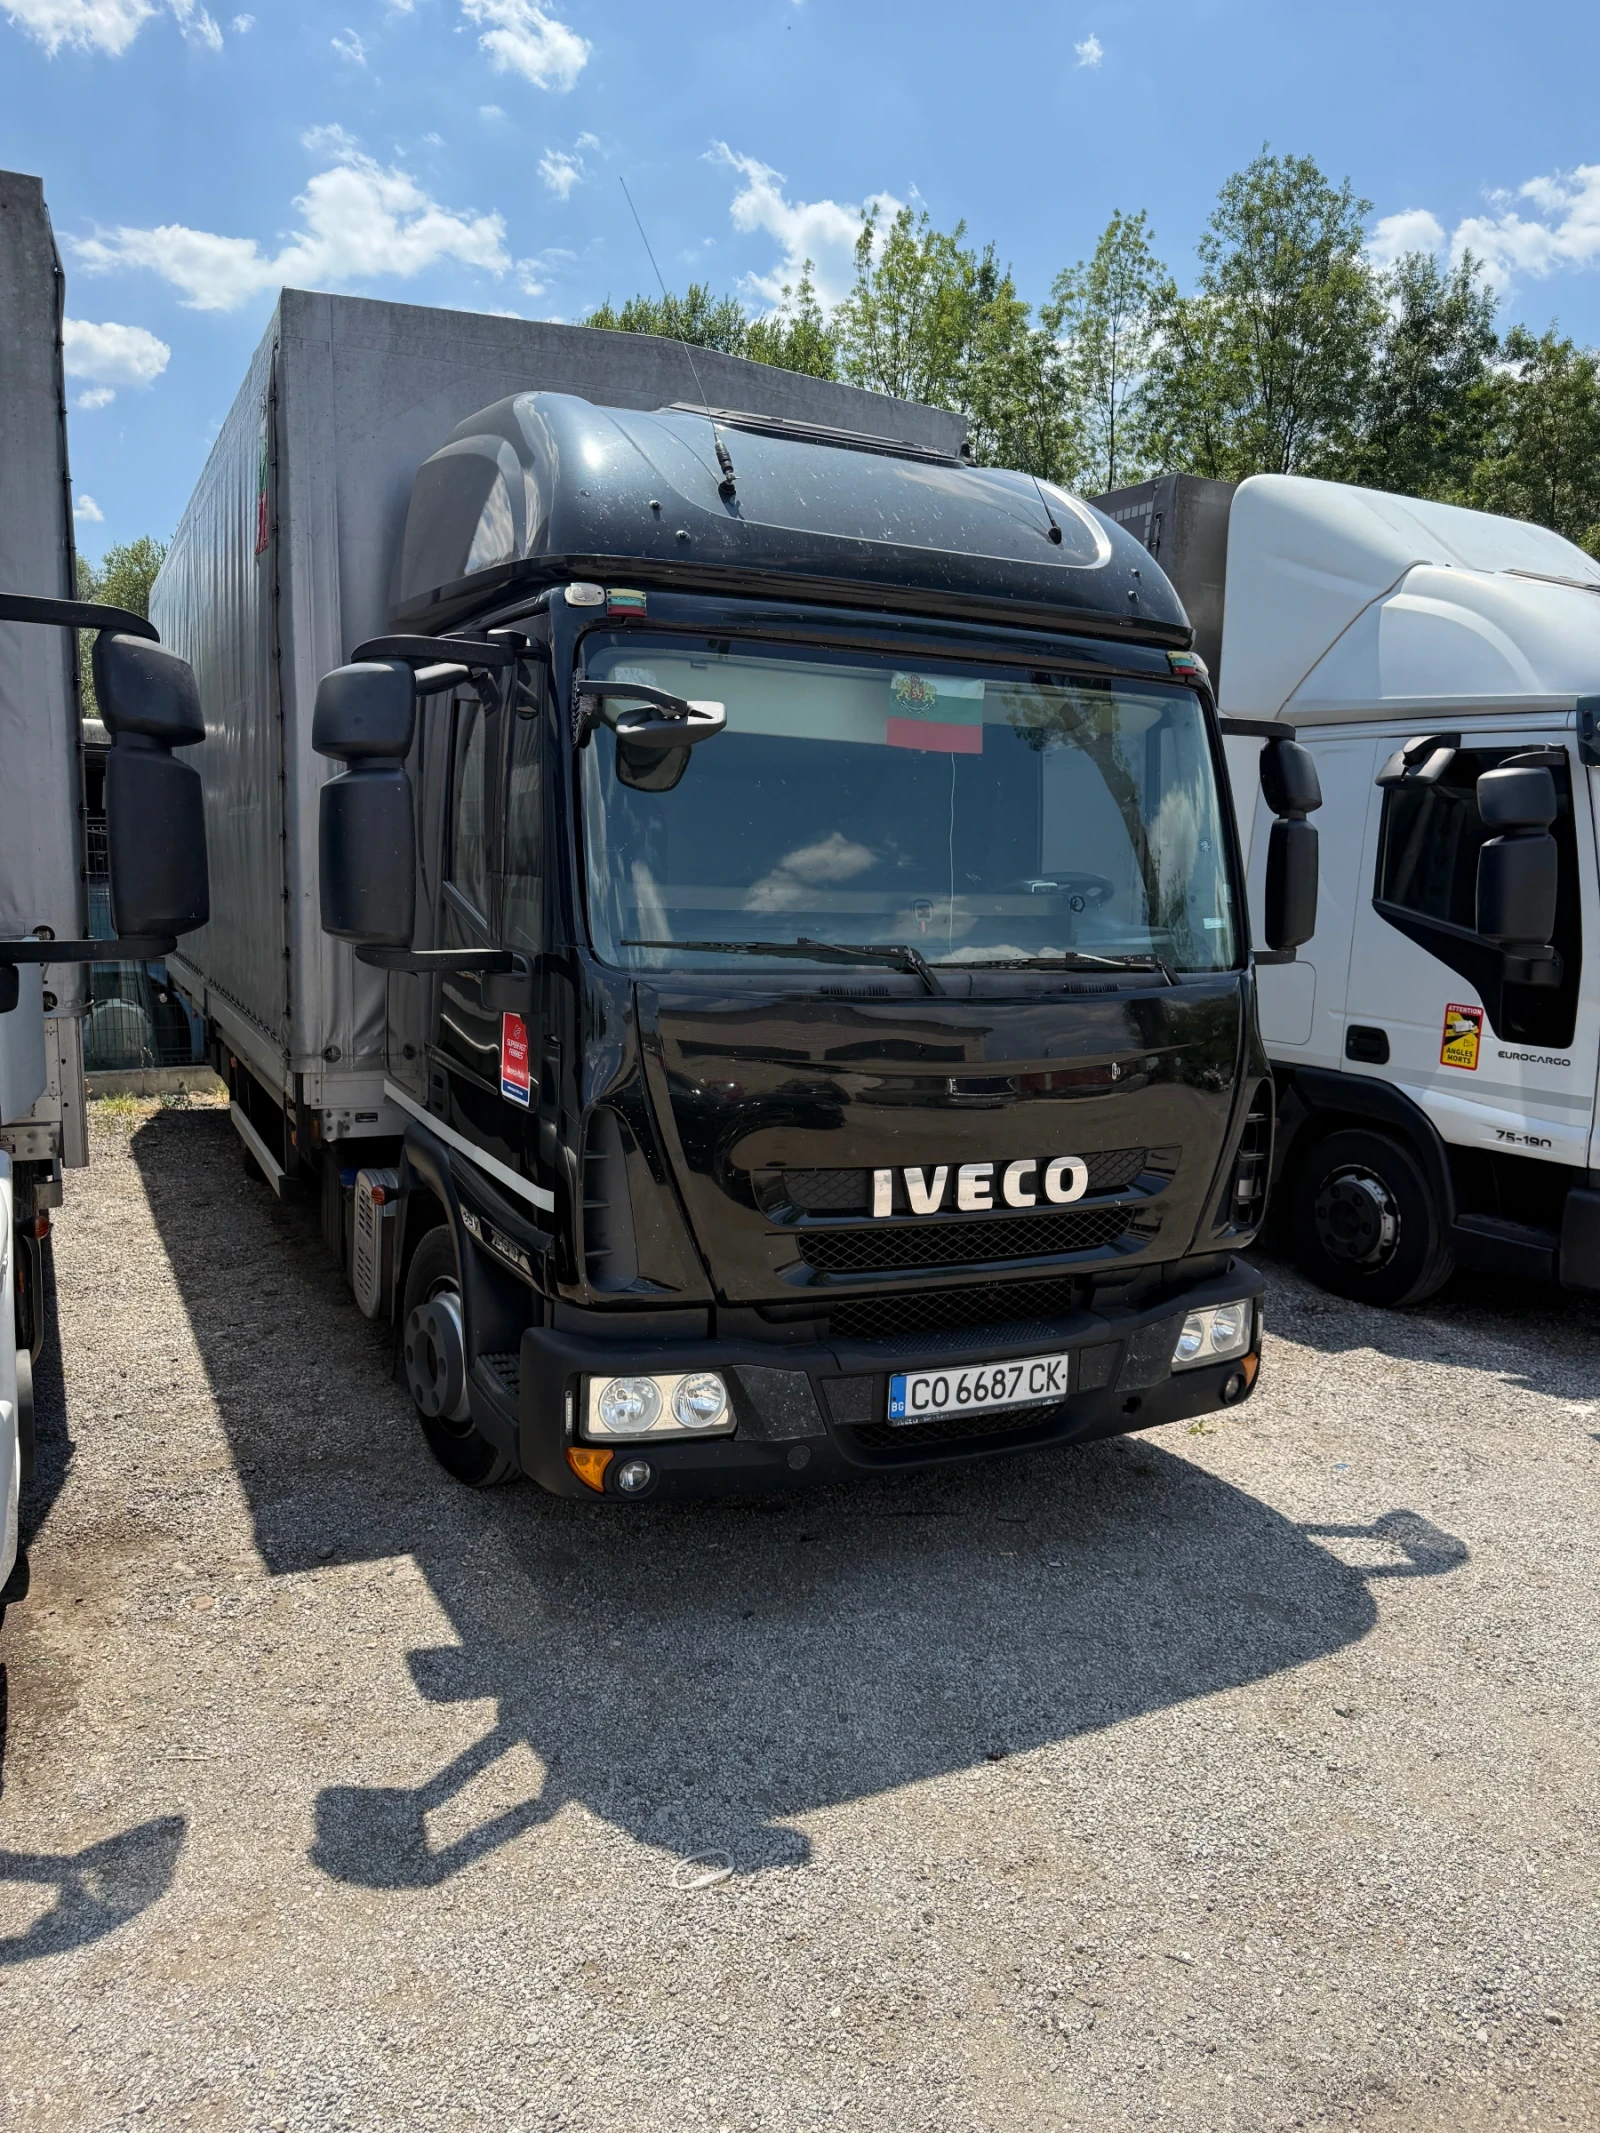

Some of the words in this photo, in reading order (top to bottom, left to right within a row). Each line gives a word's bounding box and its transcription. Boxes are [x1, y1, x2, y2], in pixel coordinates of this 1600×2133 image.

[1448, 1005, 1482, 1016] ATTENTION
[1446, 1047, 1474, 1058] ANGLES
[1447, 1054, 1471, 1065] MORTS
[1498, 1050, 1571, 1067] EUROCARGO
[1496, 1129, 1552, 1148] 75-190
[873, 1156, 1089, 1218] IVECO
[911, 1376, 950, 1411] CO
[956, 1366, 1024, 1405] 6687
[1028, 1360, 1062, 1394] CK
[891, 1401, 905, 1413] BG
